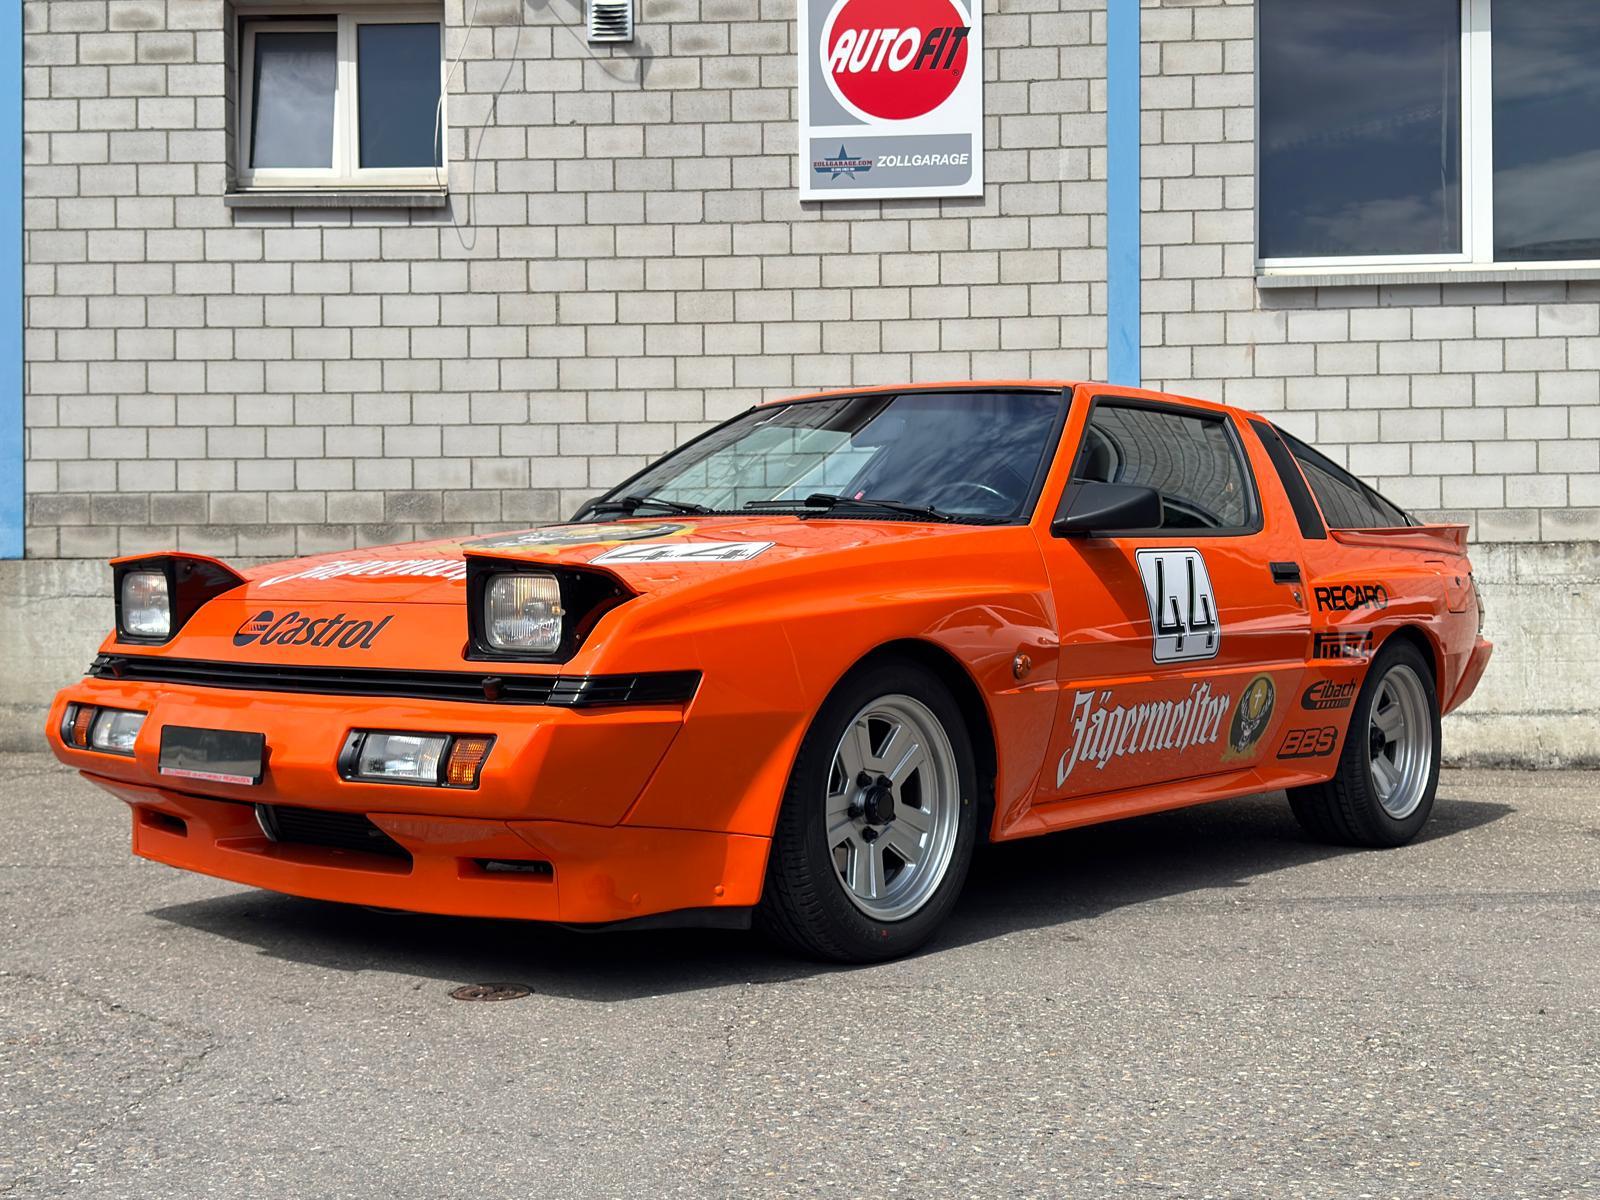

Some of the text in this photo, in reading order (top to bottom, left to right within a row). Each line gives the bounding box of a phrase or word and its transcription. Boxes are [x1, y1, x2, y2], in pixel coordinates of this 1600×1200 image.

[829, 27, 971, 73] AUTOFIT
[877, 153, 969, 168] ZOLLGARAGE
[1154, 557, 1219, 652] 44
[1314, 584, 1389, 612] RECARO
[261, 611, 394, 649] Castrol
[1301, 678, 1357, 710] Eibach
[1277, 726, 1339, 759] BBS
